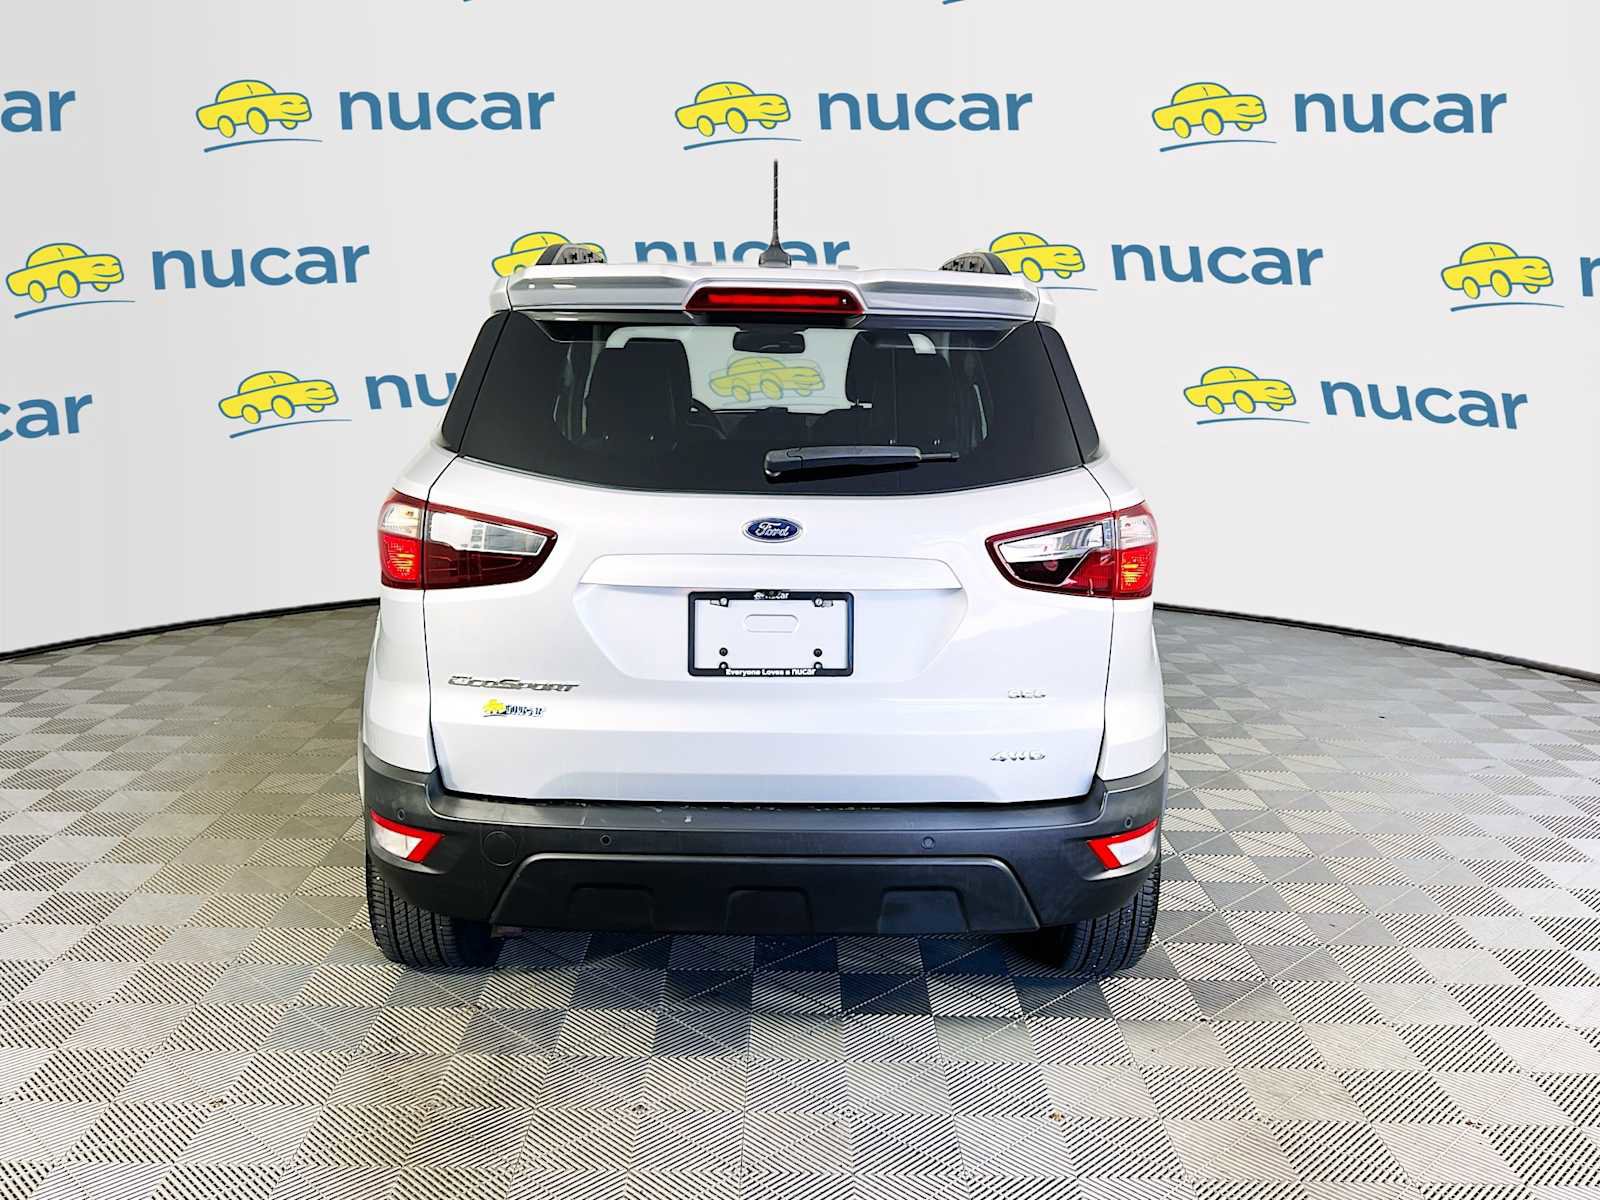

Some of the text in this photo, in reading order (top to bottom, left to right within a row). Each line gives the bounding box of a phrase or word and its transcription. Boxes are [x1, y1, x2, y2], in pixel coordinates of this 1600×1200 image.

[339, 91, 555, 131] nucar
[818, 92, 1033, 131] nucar
[1294, 93, 1507, 133] nucar
[151, 244, 370, 290] nucar
[1111, 244, 1323, 286] nucar
[1320, 380, 1528, 429] nucar
[755, 521, 790, 536] Ford
[725, 668, 761, 677] Everyone
[761, 668, 785, 676] Loves
[791, 668, 817, 676] nucar
